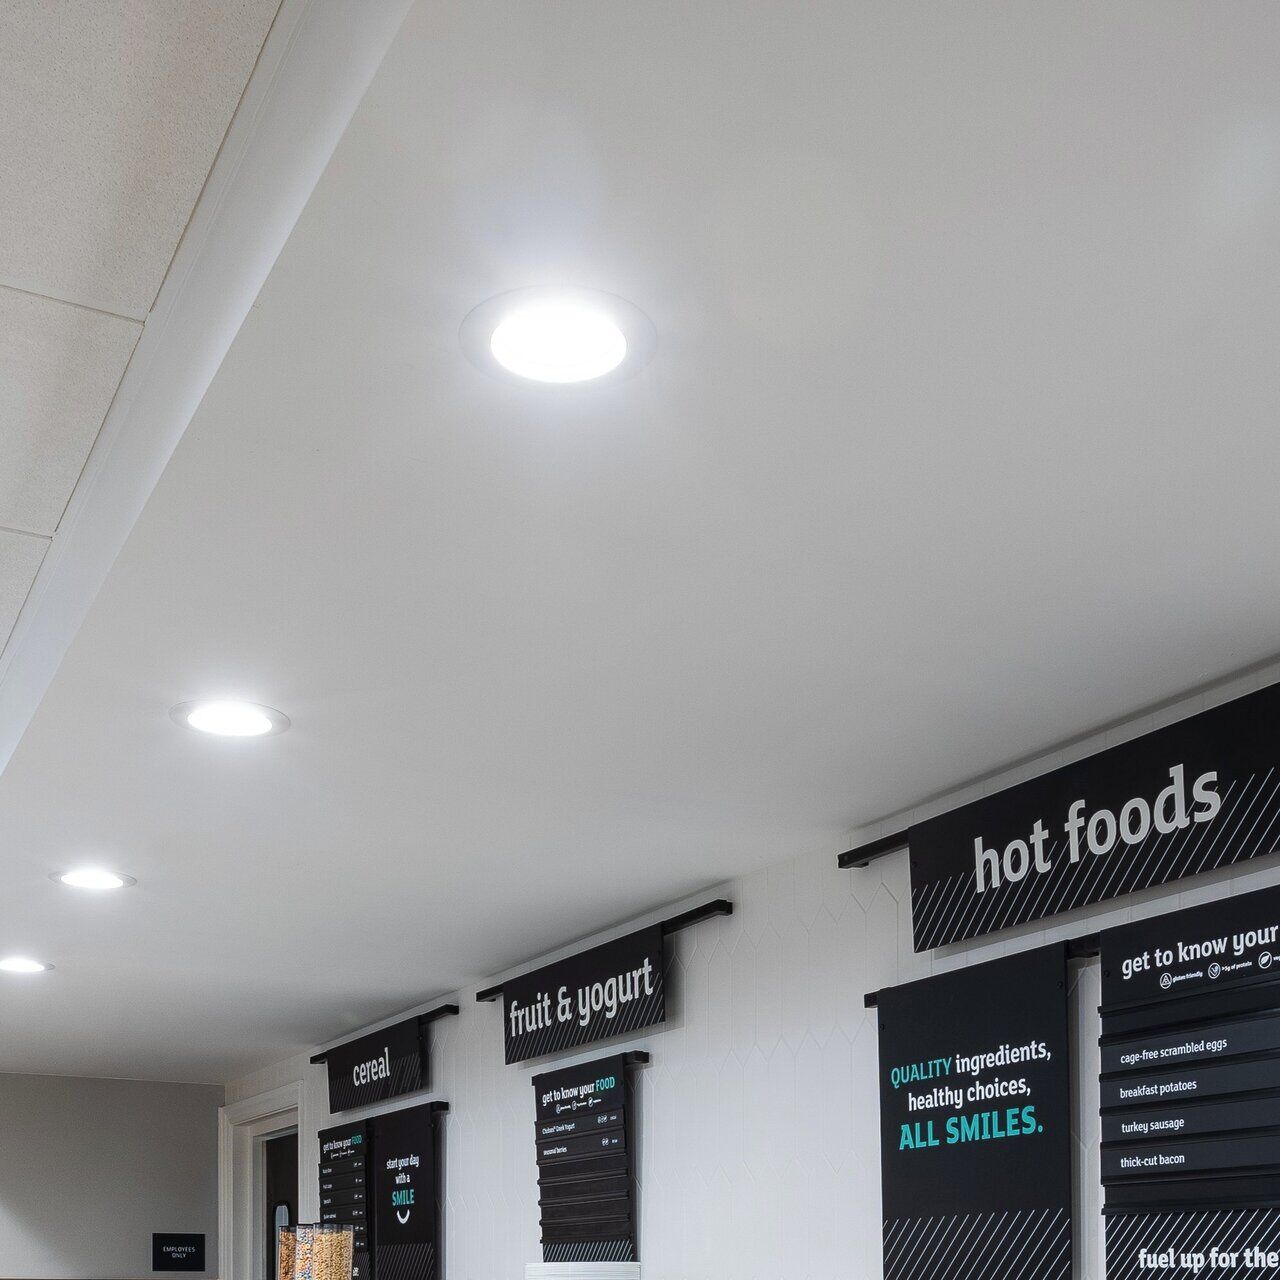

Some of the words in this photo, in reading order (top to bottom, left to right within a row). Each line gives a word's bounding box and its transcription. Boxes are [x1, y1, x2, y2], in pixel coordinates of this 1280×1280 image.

[974, 819, 1052, 894] hot
[1064, 764, 1221, 864] foods
[1122, 953, 1150, 979] get
[1154, 948, 1173, 969] to
[1178, 937, 1228, 963] know
[1232, 924, 1279, 956] your
[1236, 962, 1253, 970] protein
[510, 992, 552, 1037] fruit
[557, 986, 572, 1023] &
[578, 957, 653, 1027] yogurt
[891, 1057, 952, 1089] QUALITY
[956, 1040, 1051, 1075] ingredients,
[1120, 1050, 1159, 1065] cage-free
[1160, 1040, 1205, 1058] scrambled
[1206, 1039, 1228, 1051] eggs
[353, 1047, 390, 1086] cereal
[542, 1091, 553, 1106] get
[554, 1090, 561, 1100] to
[561, 1087, 578, 1100] know
[580, 1083, 595, 1098] your
[595, 1076, 615, 1092] FOOD
[908, 1086, 963, 1112] healthy
[967, 1078, 1031, 1102] choices,
[1120, 1084, 1158, 1099] breakfast
[1160, 1080, 1197, 1096] potatoes
[899, 1121, 940, 1150] ALL
[946, 1105, 1044, 1144] SMILES.
[1122, 1122, 1148, 1134] turkey
[1150, 1118, 1185, 1131] sausage
[386, 1158, 398, 1169] start
[398, 1158, 409, 1170] your
[410, 1154, 420, 1167] day
[1120, 1156, 1158, 1168] thick-cut
[1160, 1154, 1185, 1165] bacon
[395, 1172, 406, 1184] with
[407, 1175, 410, 1183] a
[392, 1189, 415, 1206] SMILE
[1138, 1248, 1175, 1269] fuel
[1180, 1252, 1204, 1274] up
[1210, 1247, 1239, 1268] for
[1244, 1246, 1279, 1268] the
